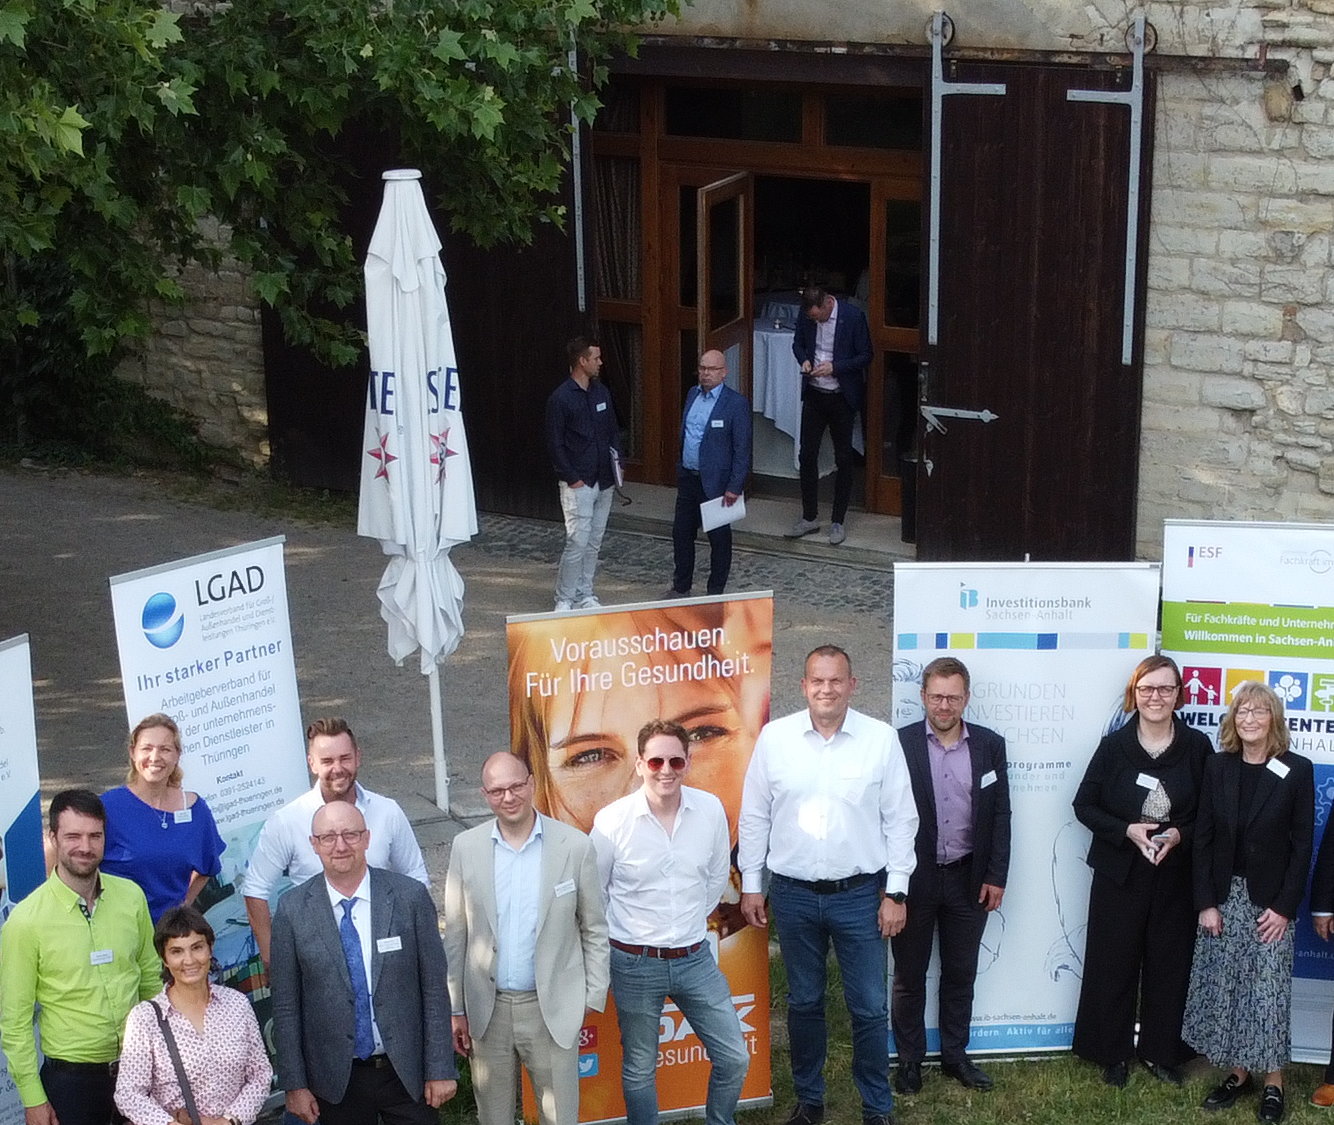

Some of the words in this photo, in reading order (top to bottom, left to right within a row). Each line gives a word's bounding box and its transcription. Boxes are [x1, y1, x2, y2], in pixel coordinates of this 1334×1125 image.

[1199, 546, 1223, 559] ESF
[195, 565, 264, 606] LGAD
[986, 596, 1092, 609] Investitionsbank
[1185, 613, 1202, 624] Für
[1204, 613, 1258, 627] Fachkräfte
[1259, 616, 1280, 628] und
[550, 627, 731, 664] Vorausschauen.
[1184, 630, 1254, 644] Willkommen
[1255, 633, 1267, 644] in
[137, 673, 161, 692] Ihr
[165, 656, 220, 684] starker
[223, 640, 283, 667] Partner
[526, 672, 561, 698] Für
[570, 666, 613, 693] Ihre
[621, 652, 755, 688] Gesundheit.
[161, 673, 256, 711] Arbeitgeberverband
[258, 669, 272, 682] für
[191, 703, 209, 719] und
[210, 684, 276, 713] Außenhandel
[967, 704, 1074, 722] NVESTIEREN
[185, 724, 201, 738] der
[203, 723, 264, 748] Dienstleister
[265, 718, 275, 729] in
[1007, 760, 1072, 771] programme
[216, 769, 244, 785] Kontakt
[1007, 1026, 1033, 1036] Aktiv
[1037, 1026, 1052, 1035] für
